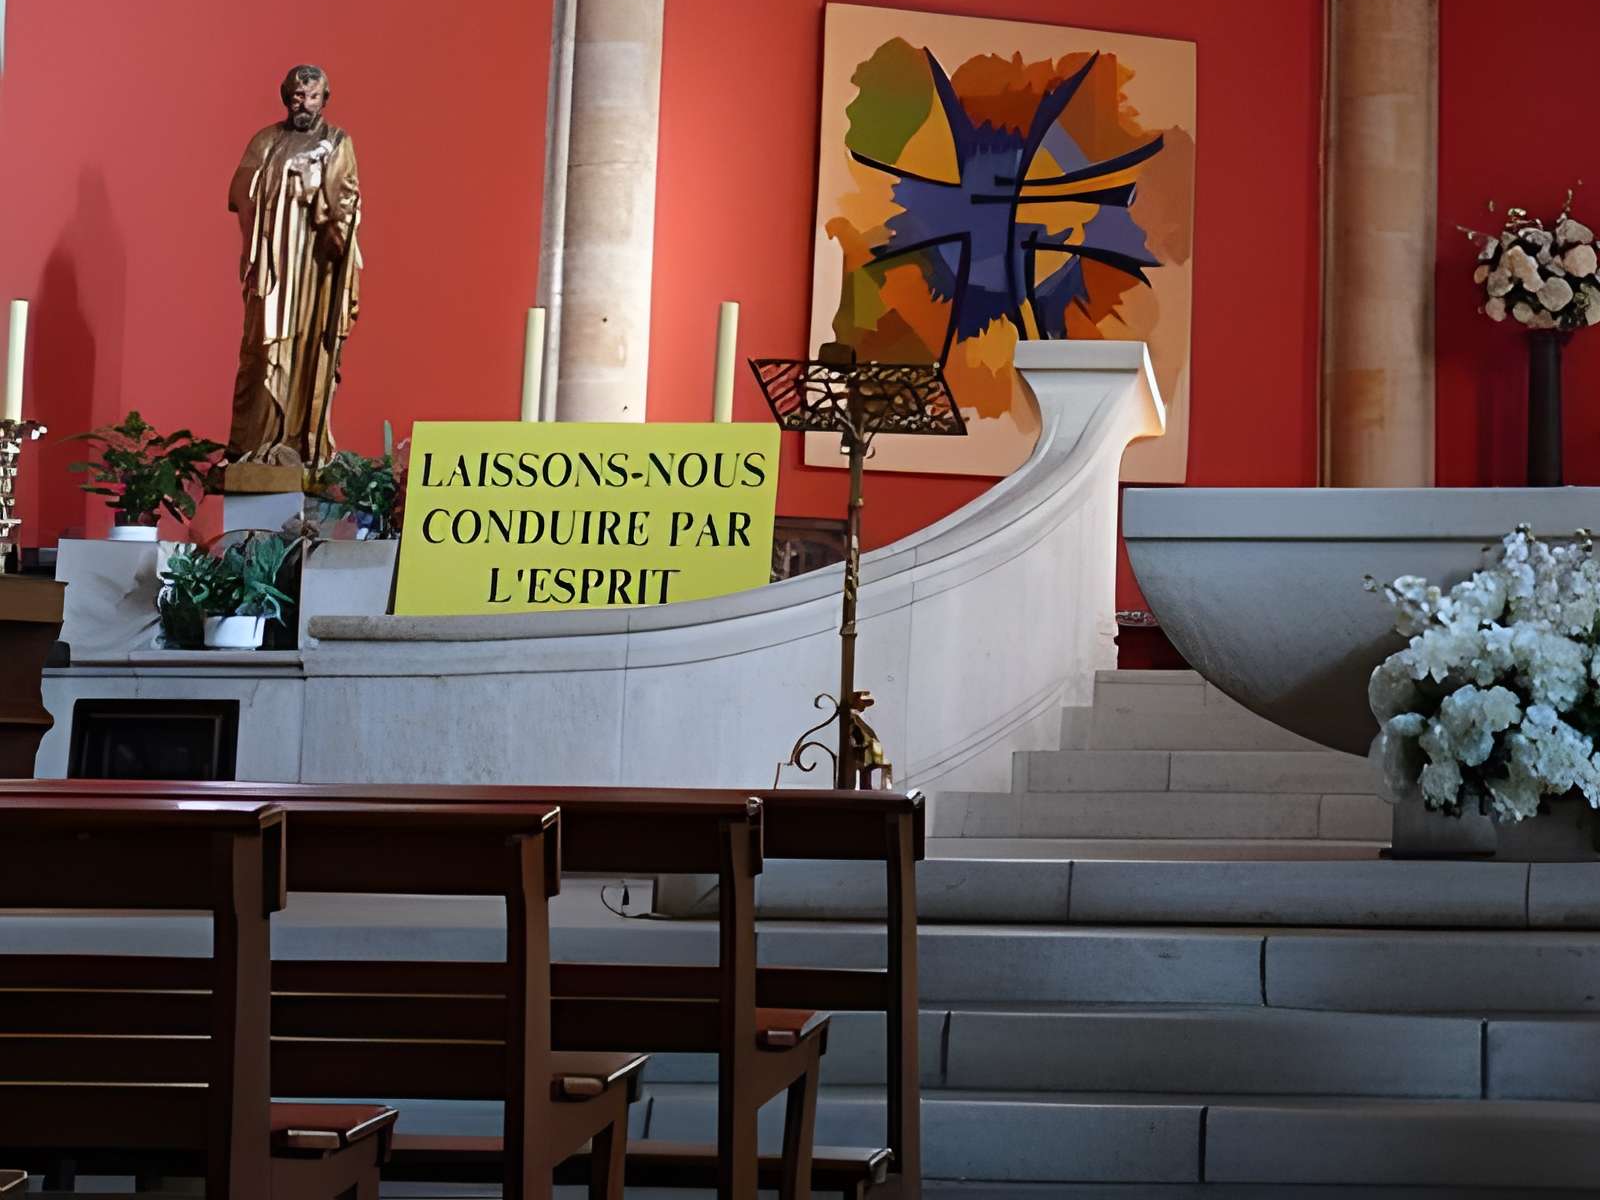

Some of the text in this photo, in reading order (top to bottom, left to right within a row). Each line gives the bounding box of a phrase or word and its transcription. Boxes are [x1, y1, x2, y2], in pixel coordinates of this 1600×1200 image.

[421, 451, 766, 488] LAISSONS-NOUS
[421, 508, 752, 547] CONDUIRE PAR
[487, 566, 681, 605] L'ESPRIT
